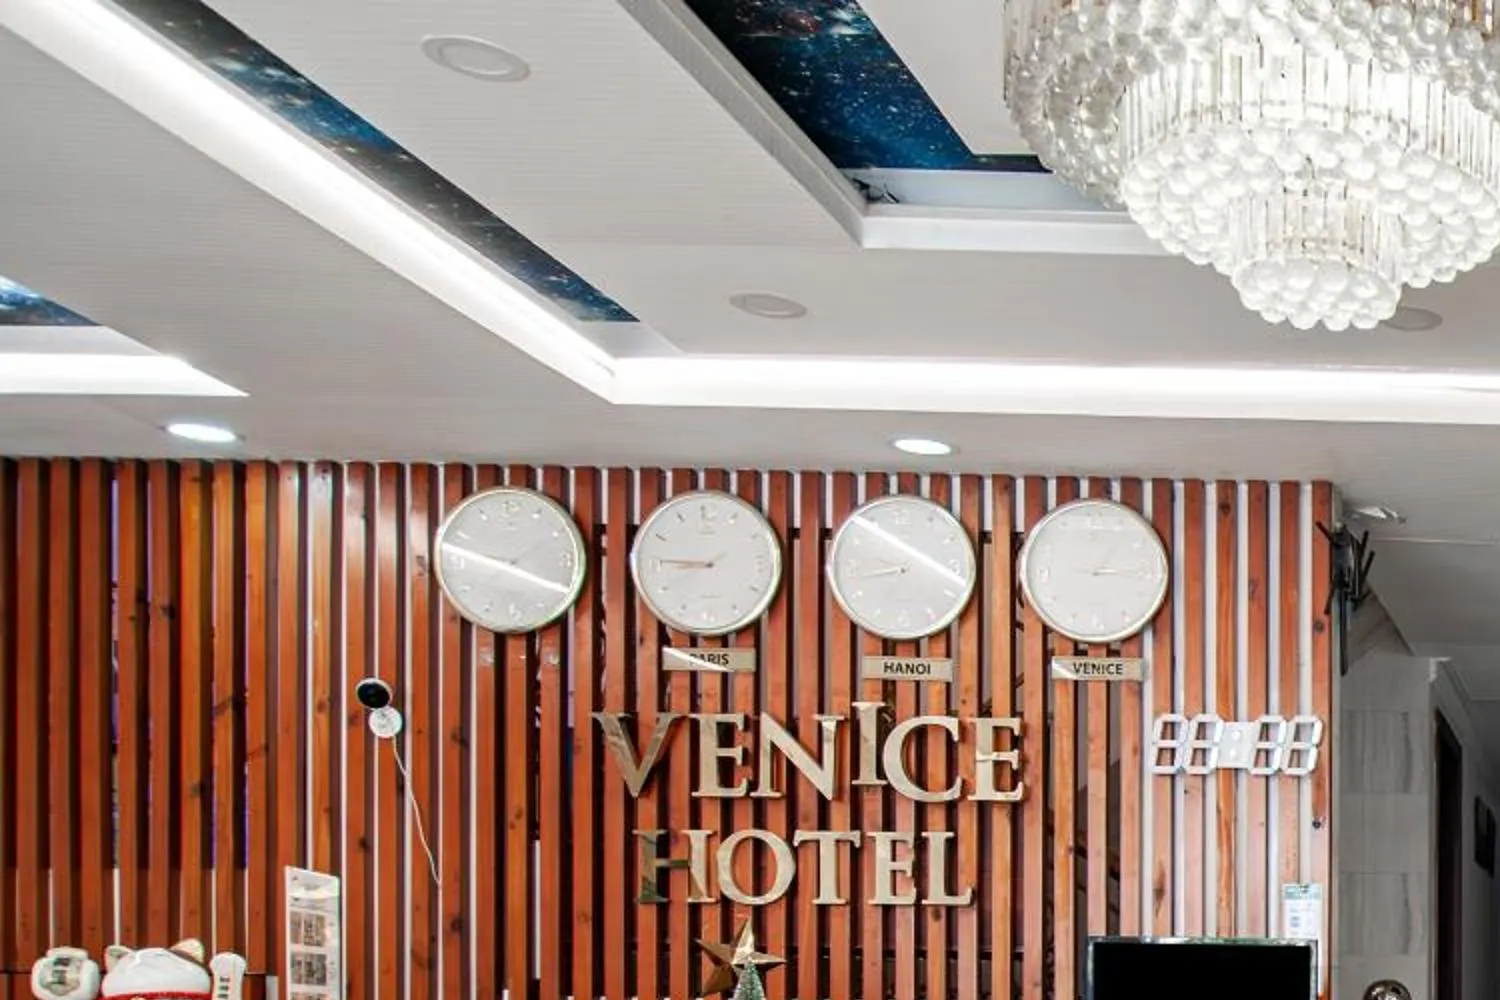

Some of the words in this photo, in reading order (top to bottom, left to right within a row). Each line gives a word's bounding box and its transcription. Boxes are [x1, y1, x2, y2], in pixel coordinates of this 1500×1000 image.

[883, 661, 931, 675] HANOI
[1073, 661, 1123, 675] VENICE
[591, 701, 1025, 803] VENICE
[633, 828, 974, 906] HOTEL
